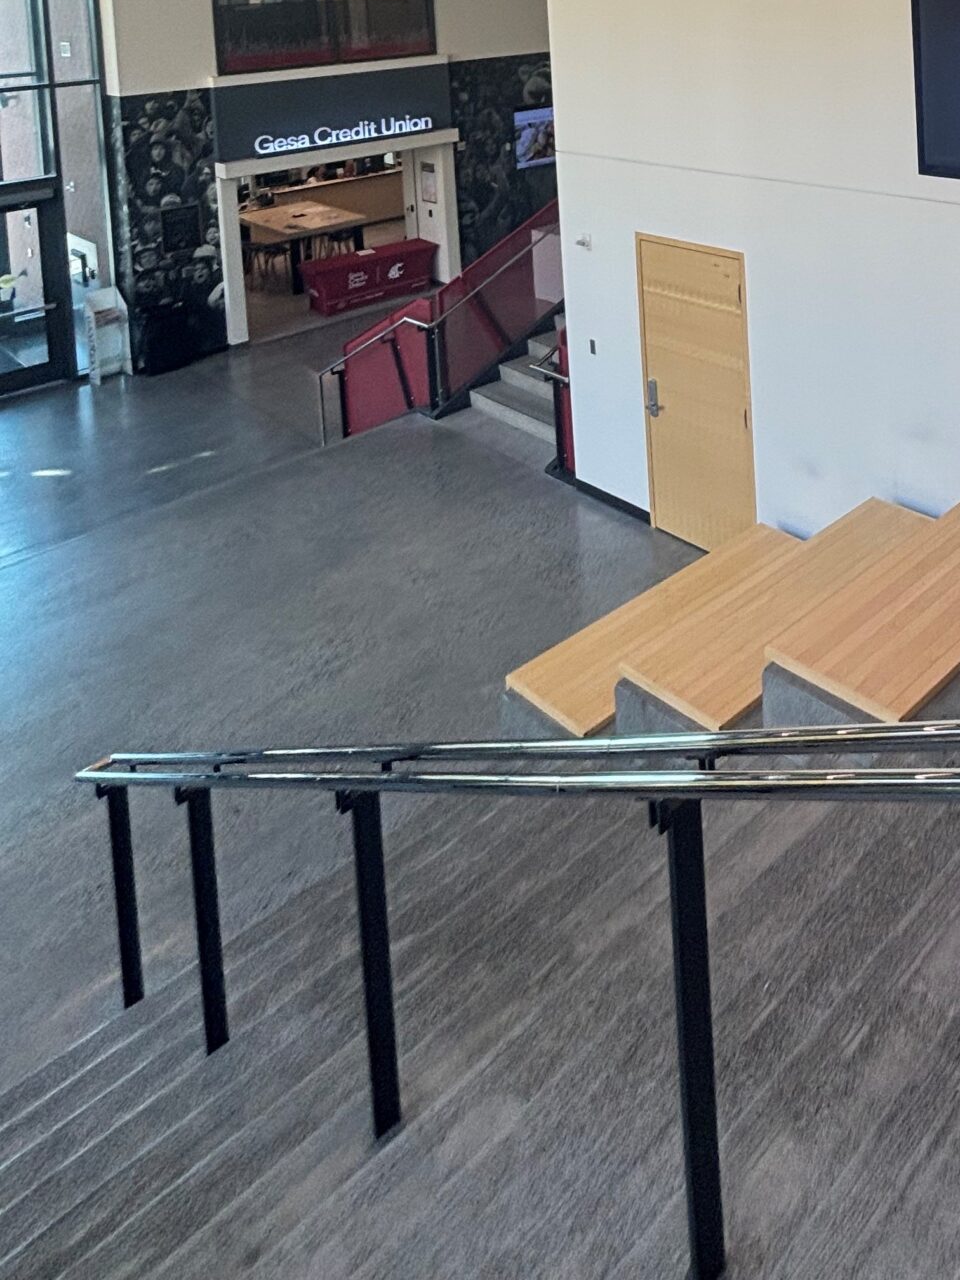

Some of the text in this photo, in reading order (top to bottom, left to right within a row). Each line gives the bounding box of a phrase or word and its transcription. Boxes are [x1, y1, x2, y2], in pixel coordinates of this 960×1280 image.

[254, 115, 432, 155] Gesa Credit Union
